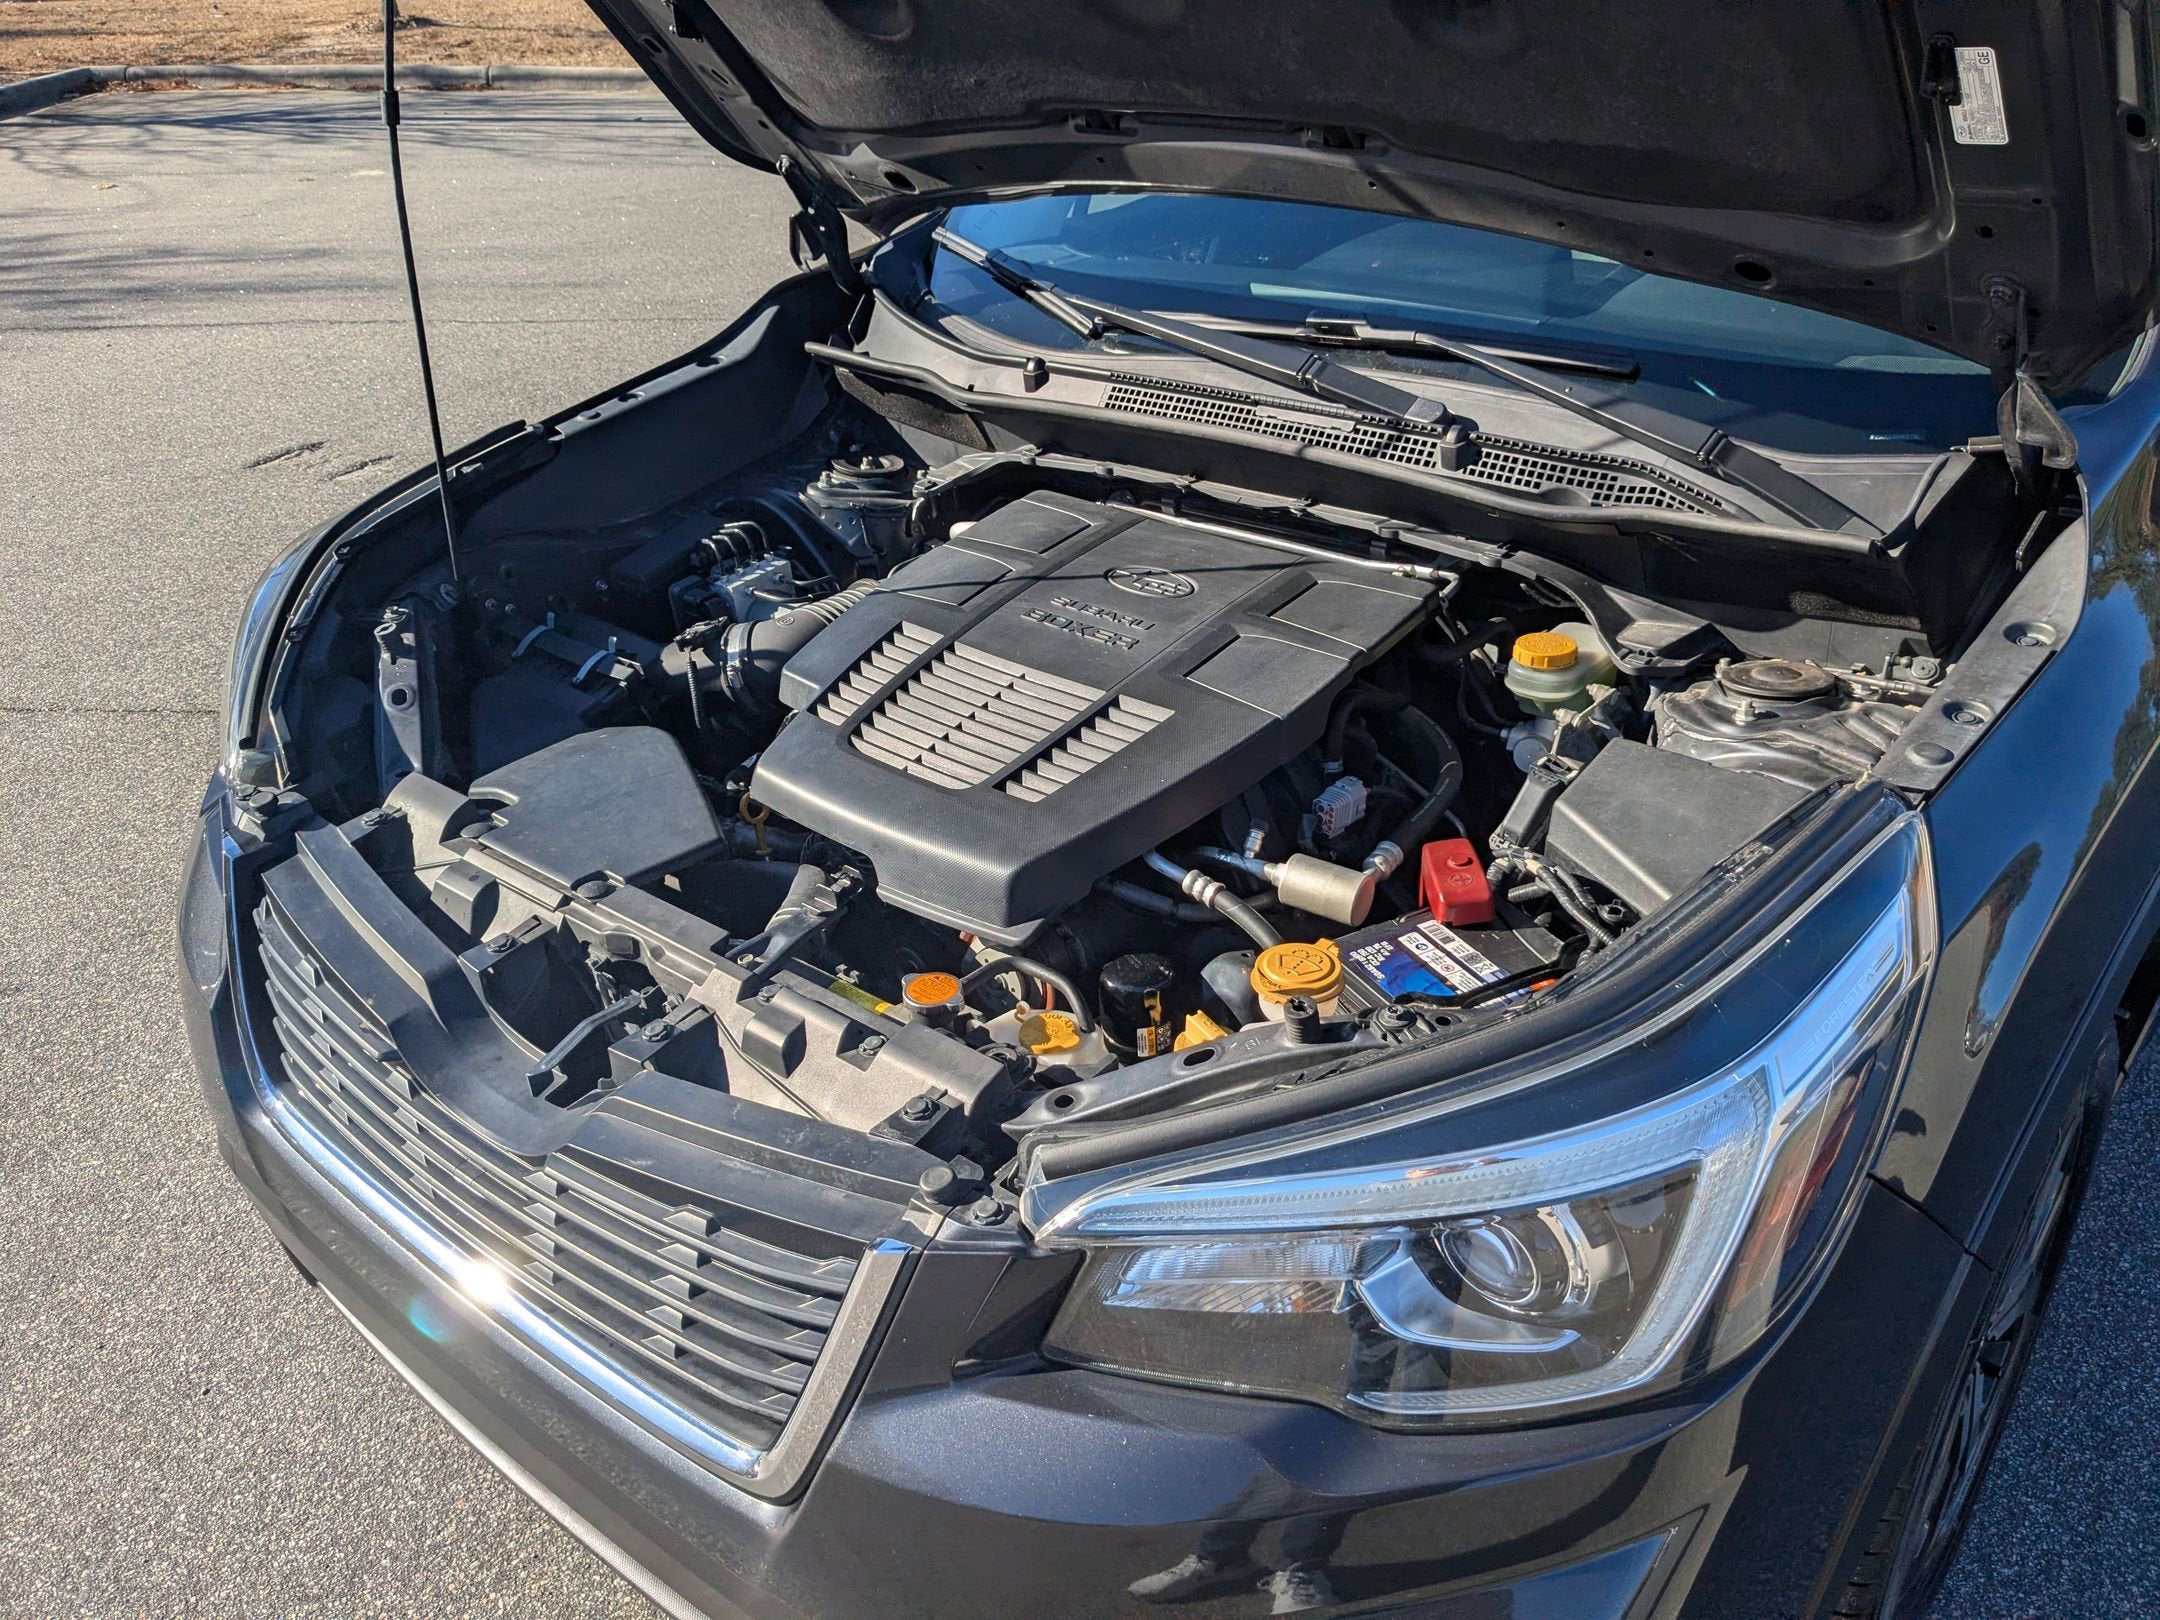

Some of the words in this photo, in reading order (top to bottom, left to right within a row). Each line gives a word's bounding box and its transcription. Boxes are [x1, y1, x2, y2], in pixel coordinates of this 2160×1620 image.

[1977, 51, 1990, 65] GE
[1020, 607, 1140, 650] BOXER
[1050, 596, 1156, 630] SUBARU
[1813, 969, 1874, 1042] FORESTER
